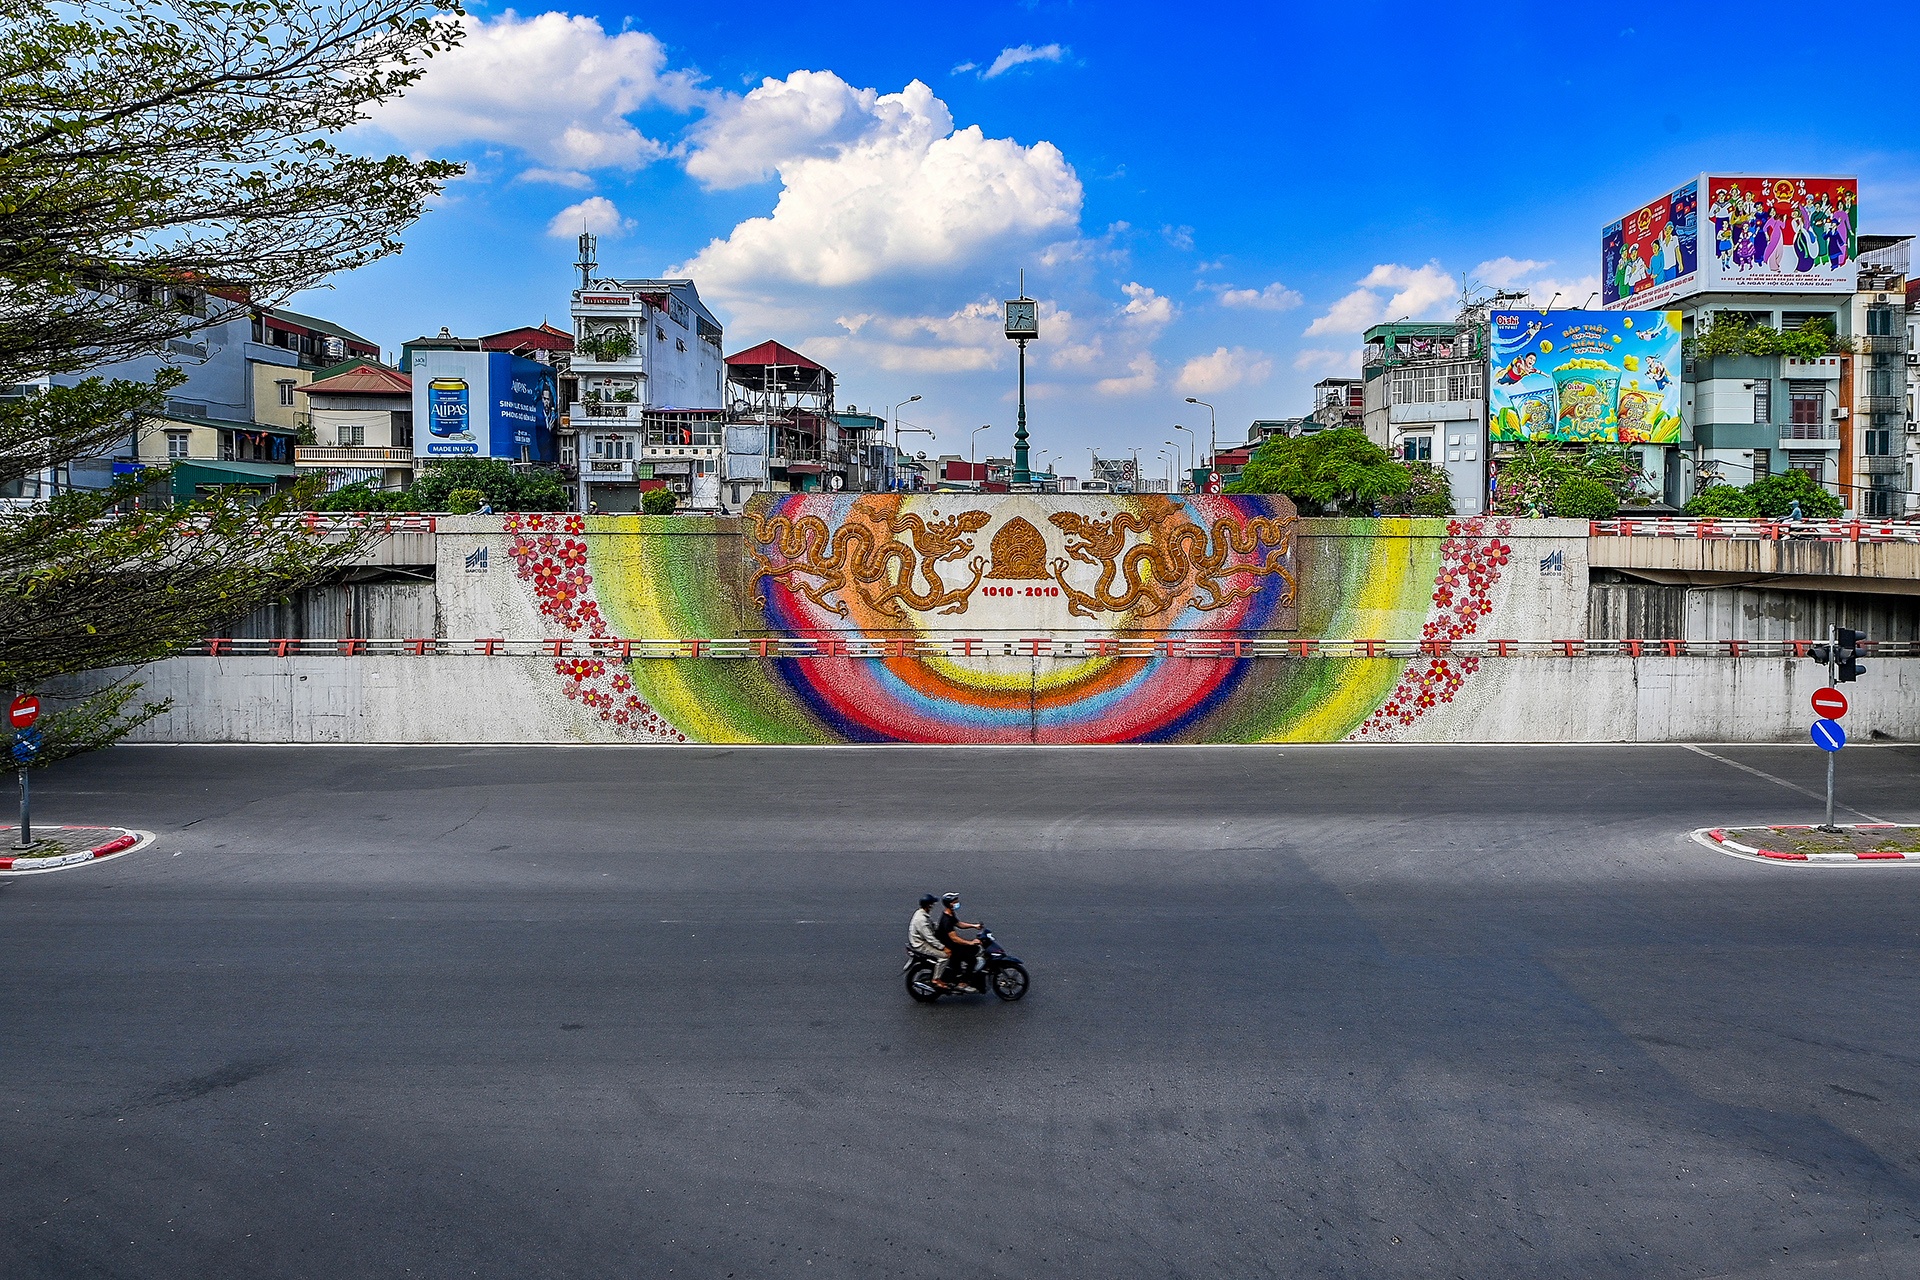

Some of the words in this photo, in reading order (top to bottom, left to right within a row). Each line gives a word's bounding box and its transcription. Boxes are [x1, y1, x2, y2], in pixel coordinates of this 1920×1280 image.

[1496, 315, 1519, 325] Oishi
[982, 587, 1014, 597] 1010
[1025, 587, 1059, 597] 2010
